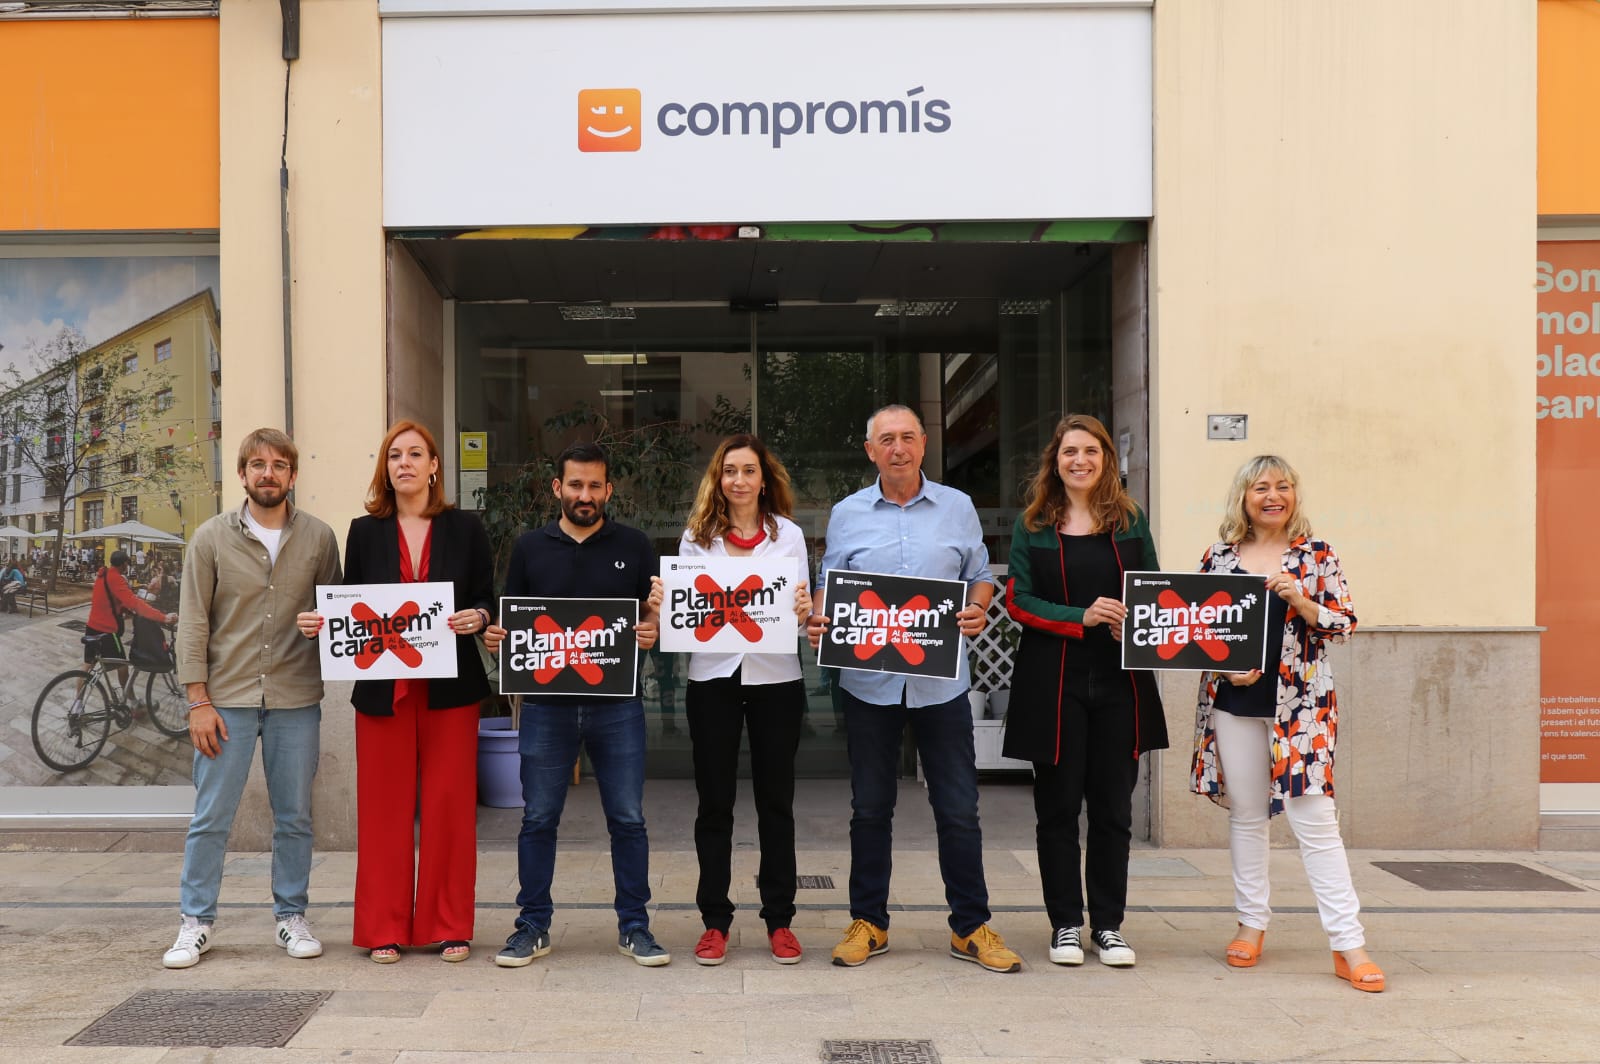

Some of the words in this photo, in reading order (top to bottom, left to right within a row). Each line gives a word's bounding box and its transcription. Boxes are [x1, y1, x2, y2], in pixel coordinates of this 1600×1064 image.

[657, 85, 952, 148] compromís
[671, 586, 774, 611] Plantem
[671, 610, 725, 629] cara
[833, 602, 940, 628] Plantem
[1134, 602, 1242, 628] Plantem
[328, 613, 431, 640] Plantem
[831, 626, 887, 645] cara
[1133, 626, 1189, 646] cara
[330, 637, 384, 657] cara
[399, 636, 422, 644] govern
[511, 627, 614, 653] Plantem
[510, 651, 565, 671] cara
[589, 657, 620, 666] vergonya
[1541, 719, 1572, 728] present
[1550, 754, 1566, 762] que
